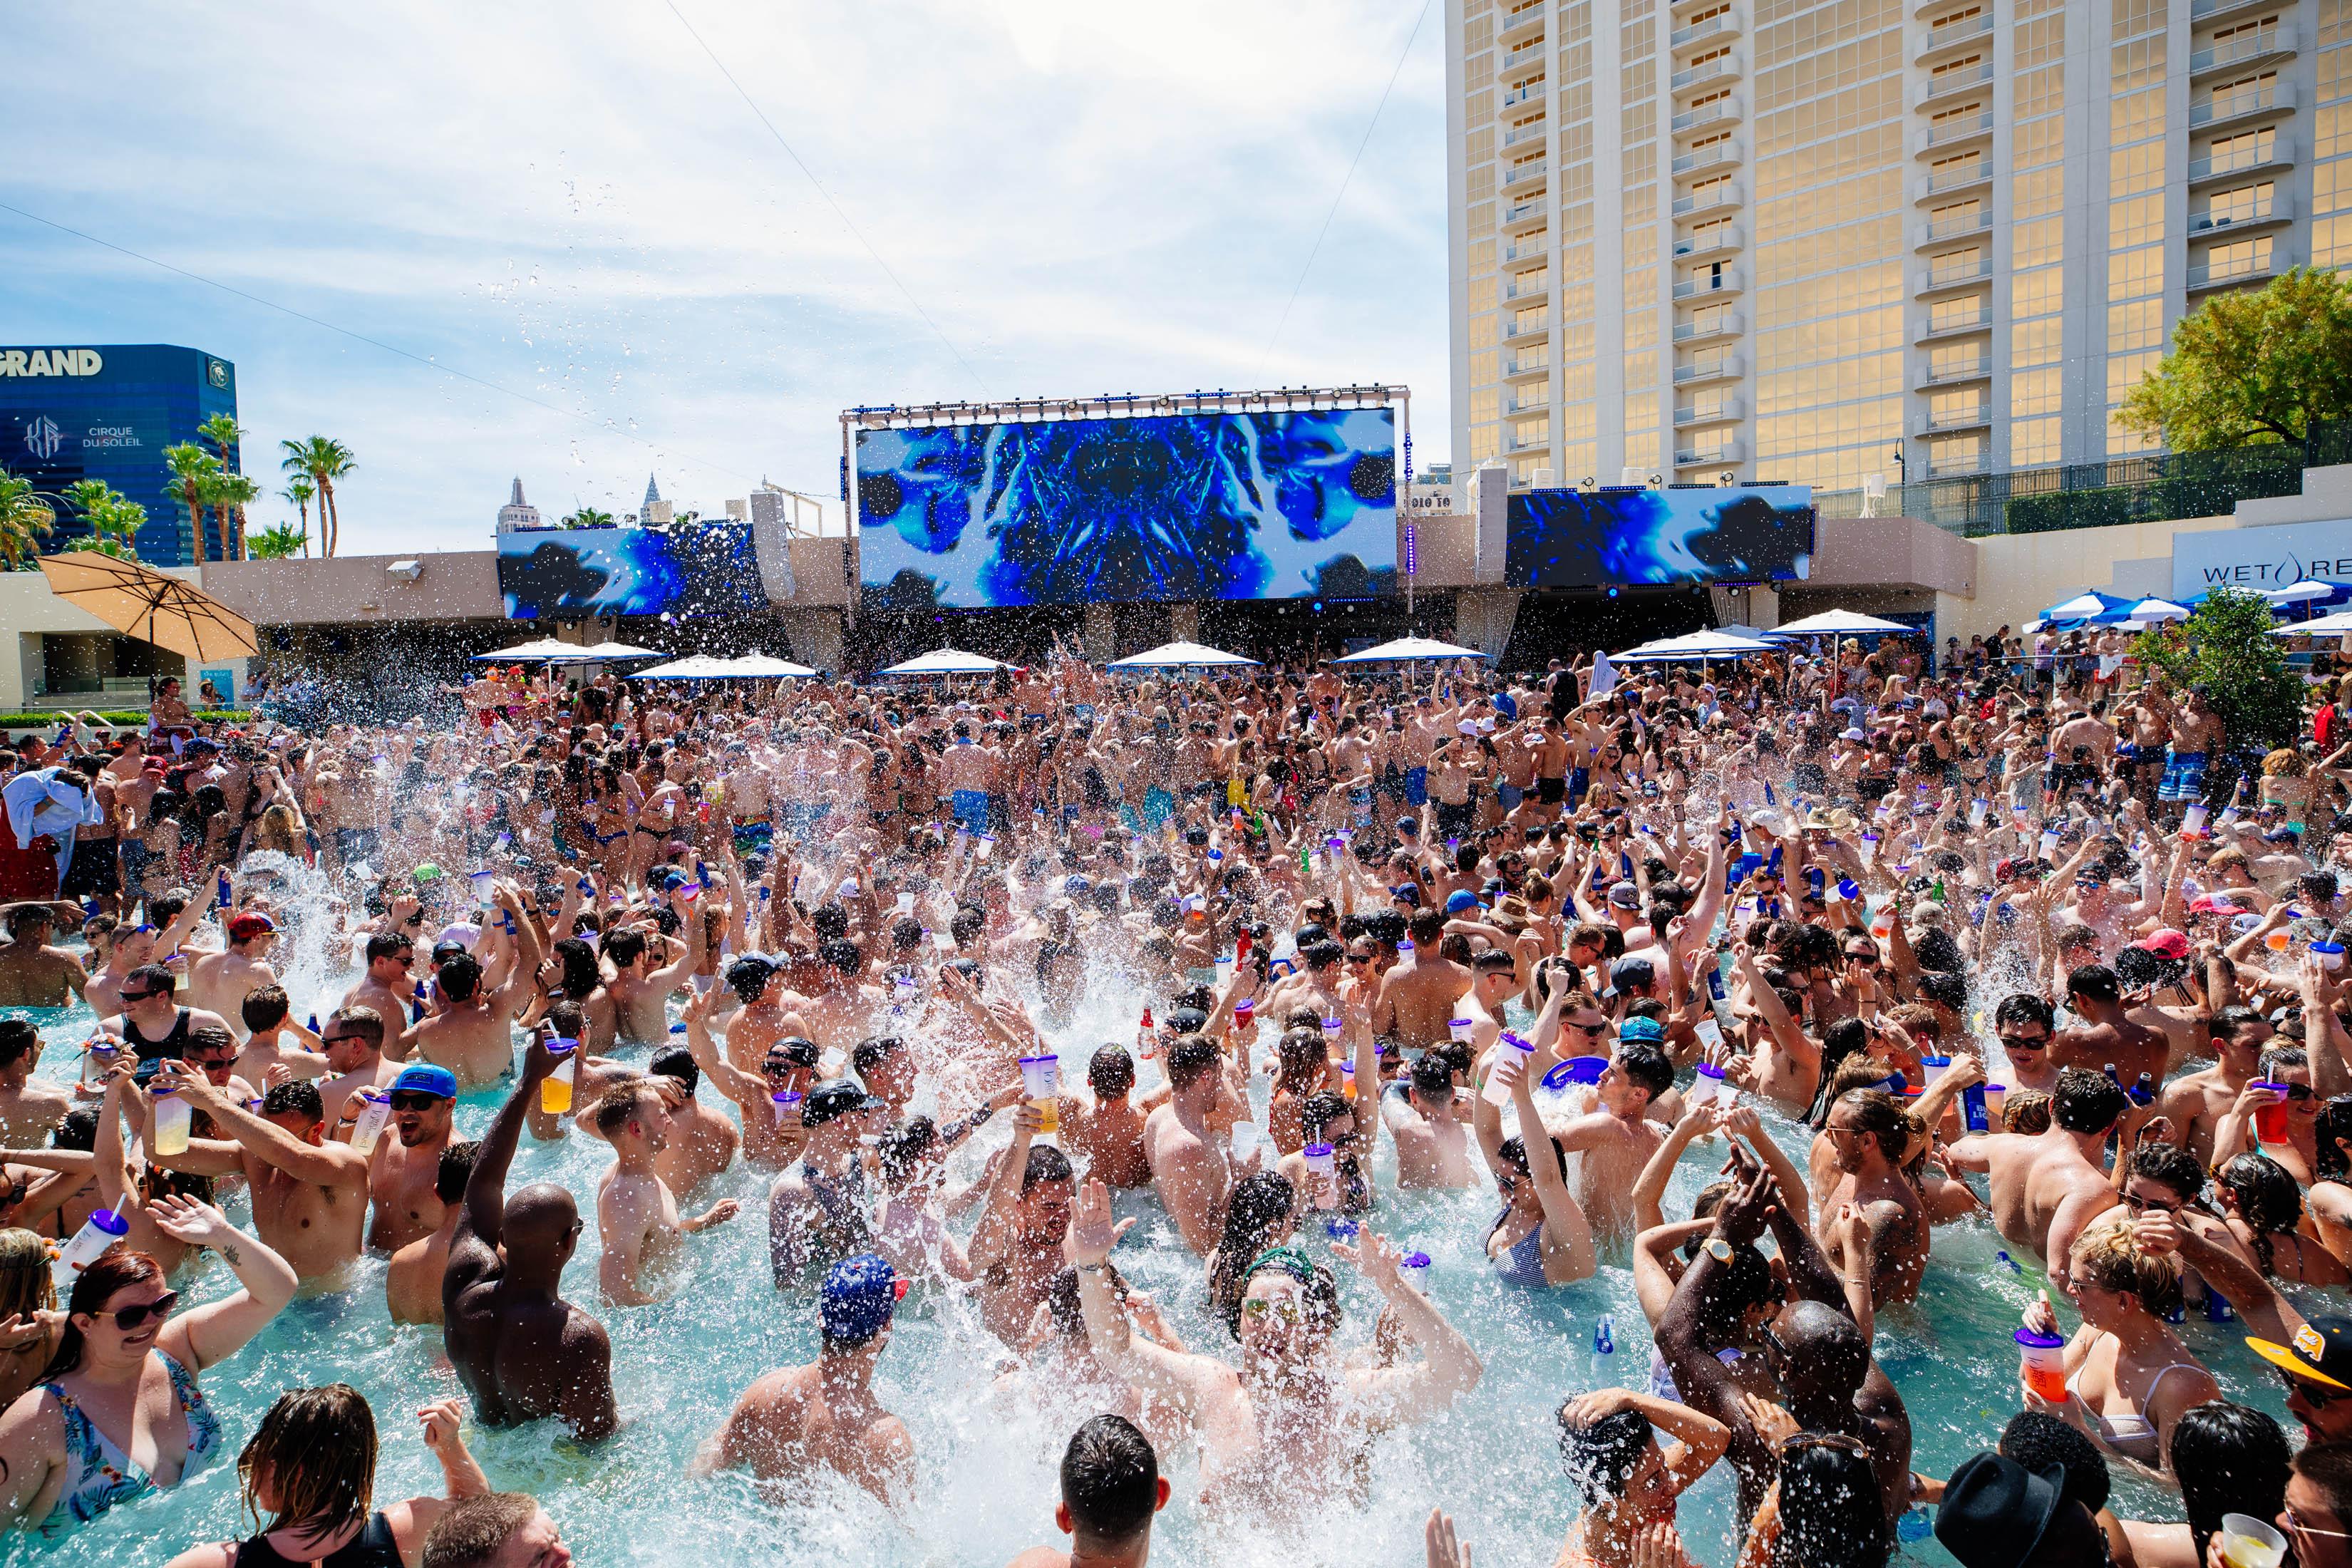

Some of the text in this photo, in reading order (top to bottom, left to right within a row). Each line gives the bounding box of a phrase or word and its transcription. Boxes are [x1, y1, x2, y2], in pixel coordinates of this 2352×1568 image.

[0, 349, 103, 376] RAND
[89, 427, 133, 438] CIRQUE
[83, 438, 143, 448] DU SOLEIL
[2204, 564, 2272, 582] WET
